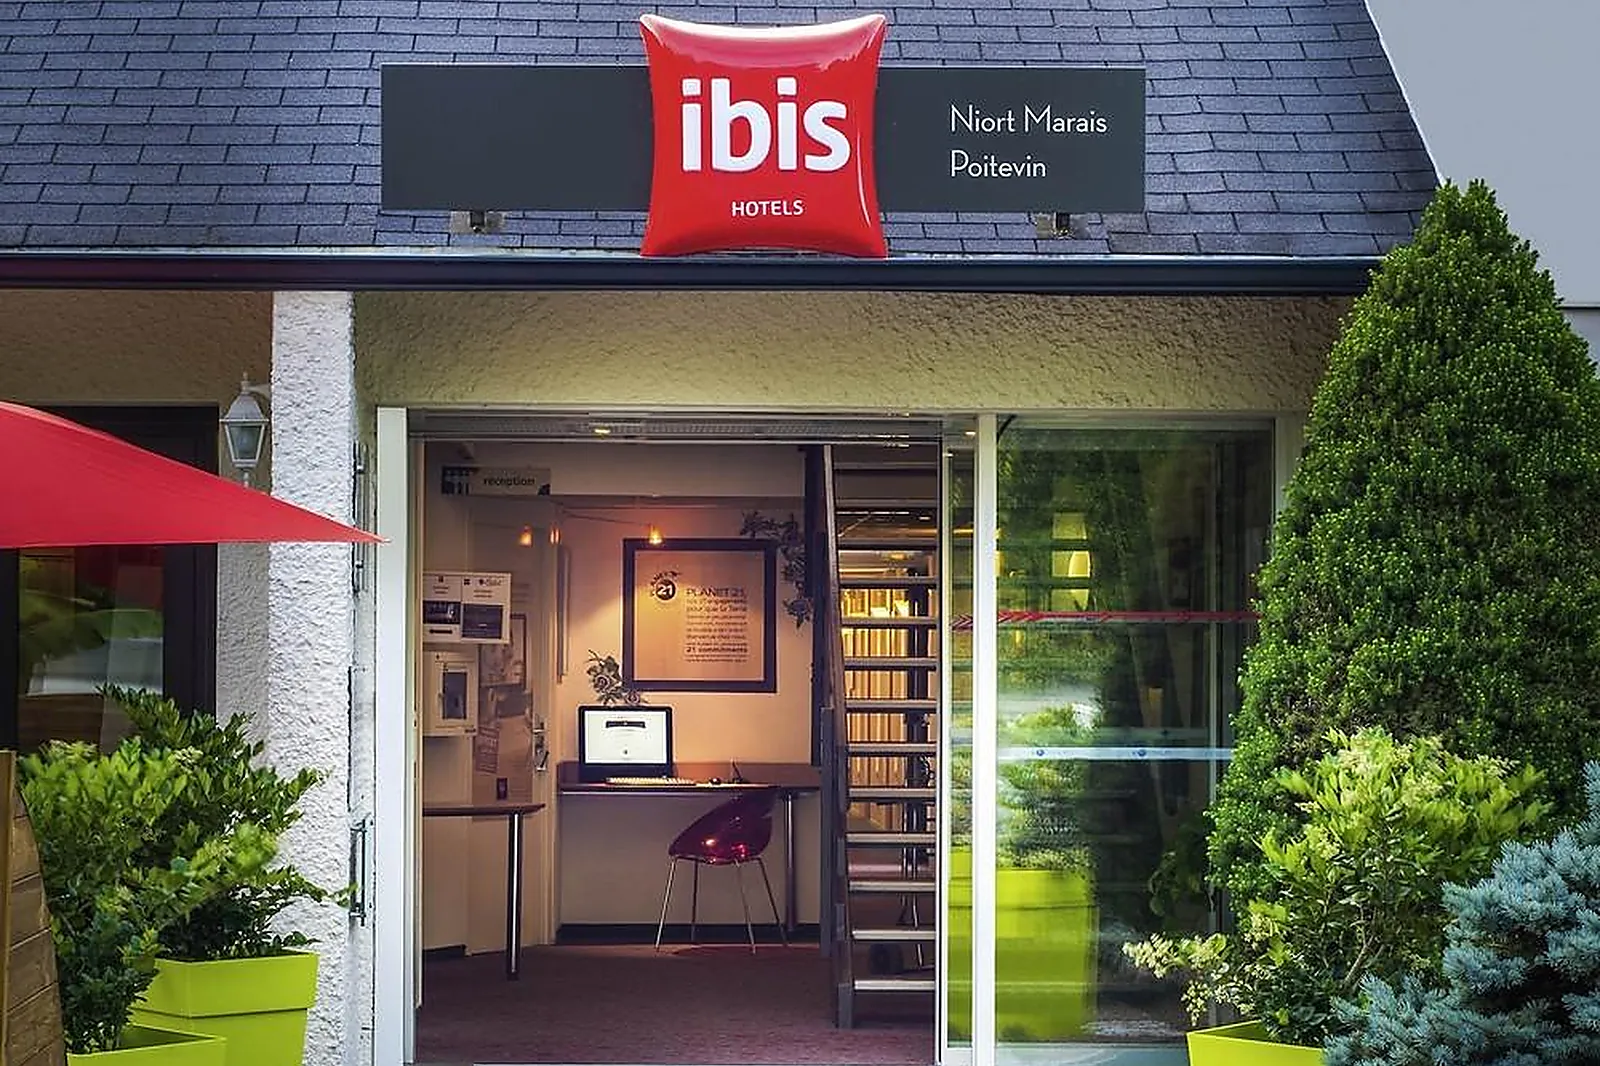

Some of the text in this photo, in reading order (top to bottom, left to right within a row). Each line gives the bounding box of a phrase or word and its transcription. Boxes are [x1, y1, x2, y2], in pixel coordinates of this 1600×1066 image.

[682, 77, 851, 172] ibis
[950, 104, 1108, 134] Niort Marais
[950, 149, 1047, 179] Poitevin
[731, 199, 805, 218] HOTELS
